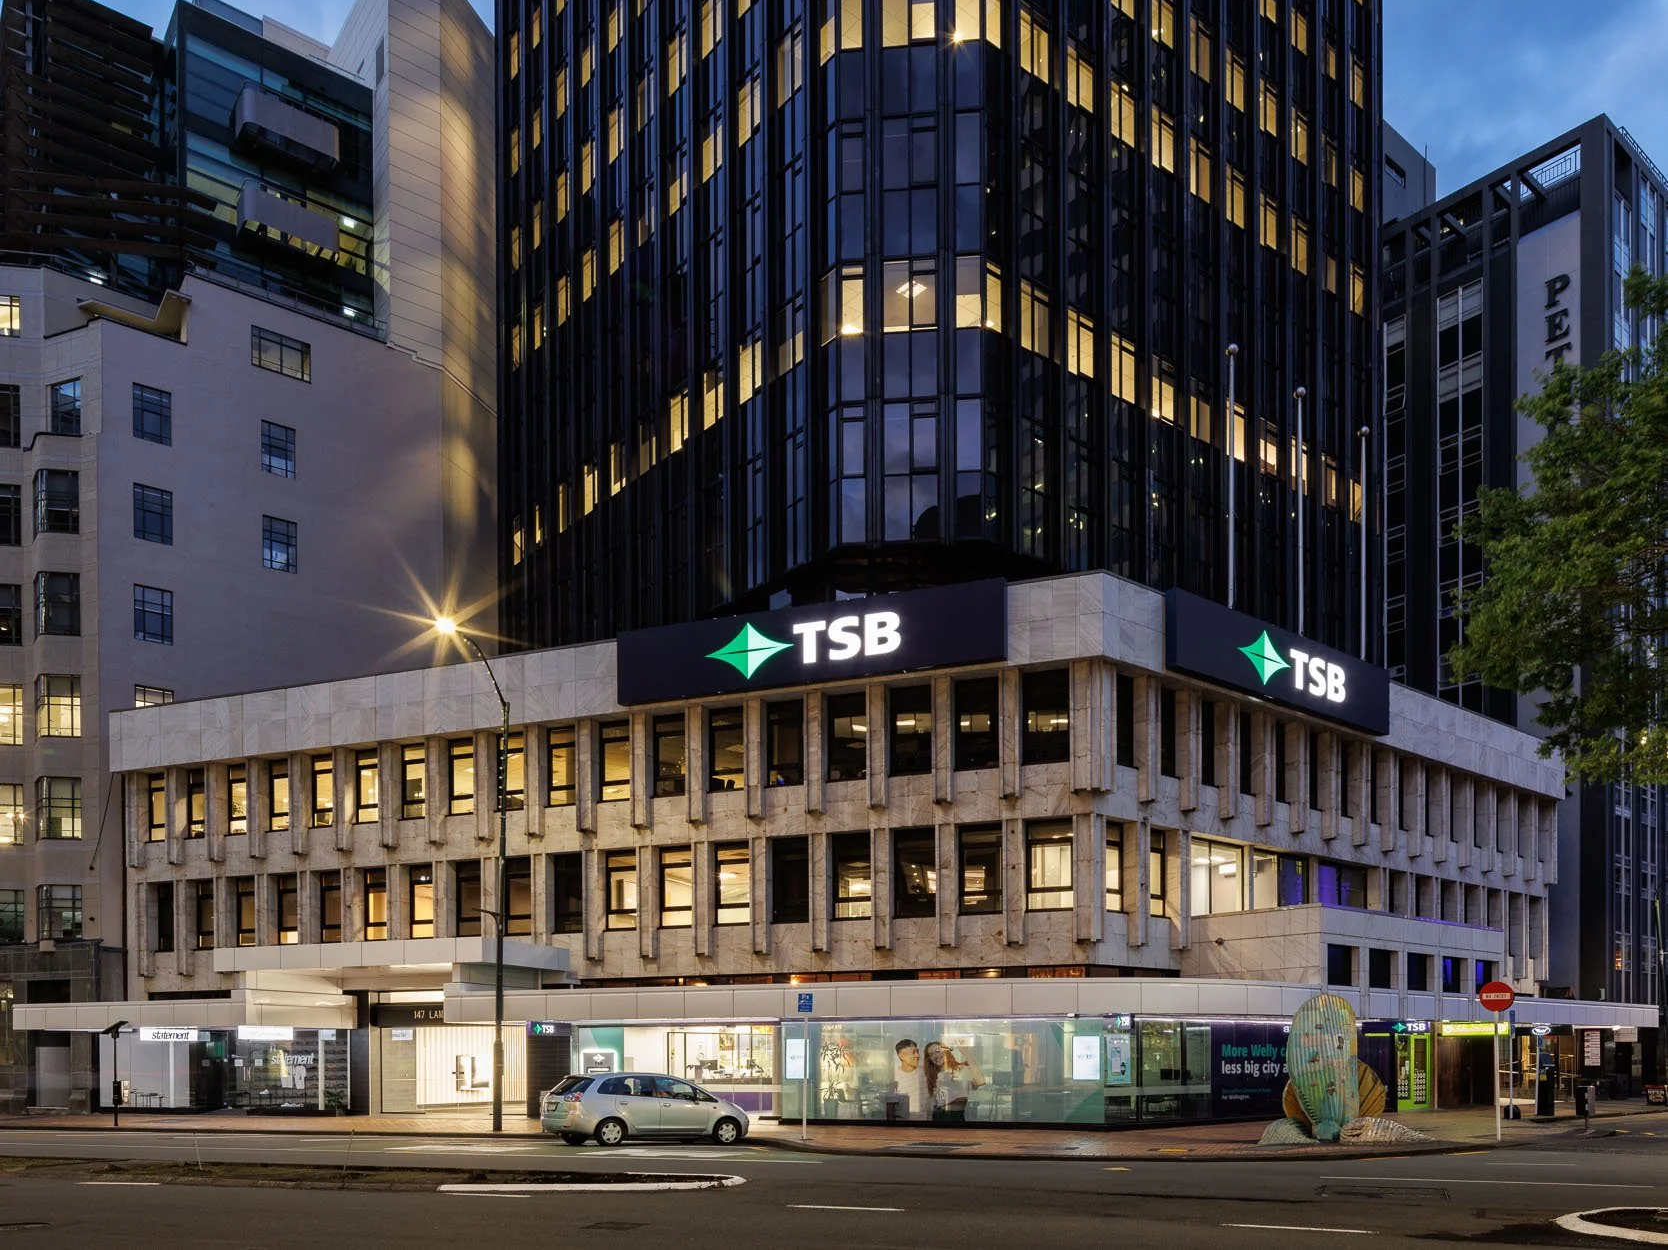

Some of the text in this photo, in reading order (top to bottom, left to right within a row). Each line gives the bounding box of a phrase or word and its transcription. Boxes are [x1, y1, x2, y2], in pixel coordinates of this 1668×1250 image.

[792, 611, 902, 665] TSB
[1289, 648, 1346, 704] TSB
[413, 1010, 425, 1019] 147
[1120, 1016, 1130, 1026] TSB
[541, 1024, 554, 1034] TSB
[1406, 1022, 1427, 1032] TSB
[151, 1030, 190, 1040] statement
[1221, 1044, 1248, 1058] More
[1250, 1043, 1279, 1060] Welly
[1221, 1060, 1242, 1075] less
[1244, 1060, 1260, 1078] big
[1262, 1060, 1281, 1078] city
